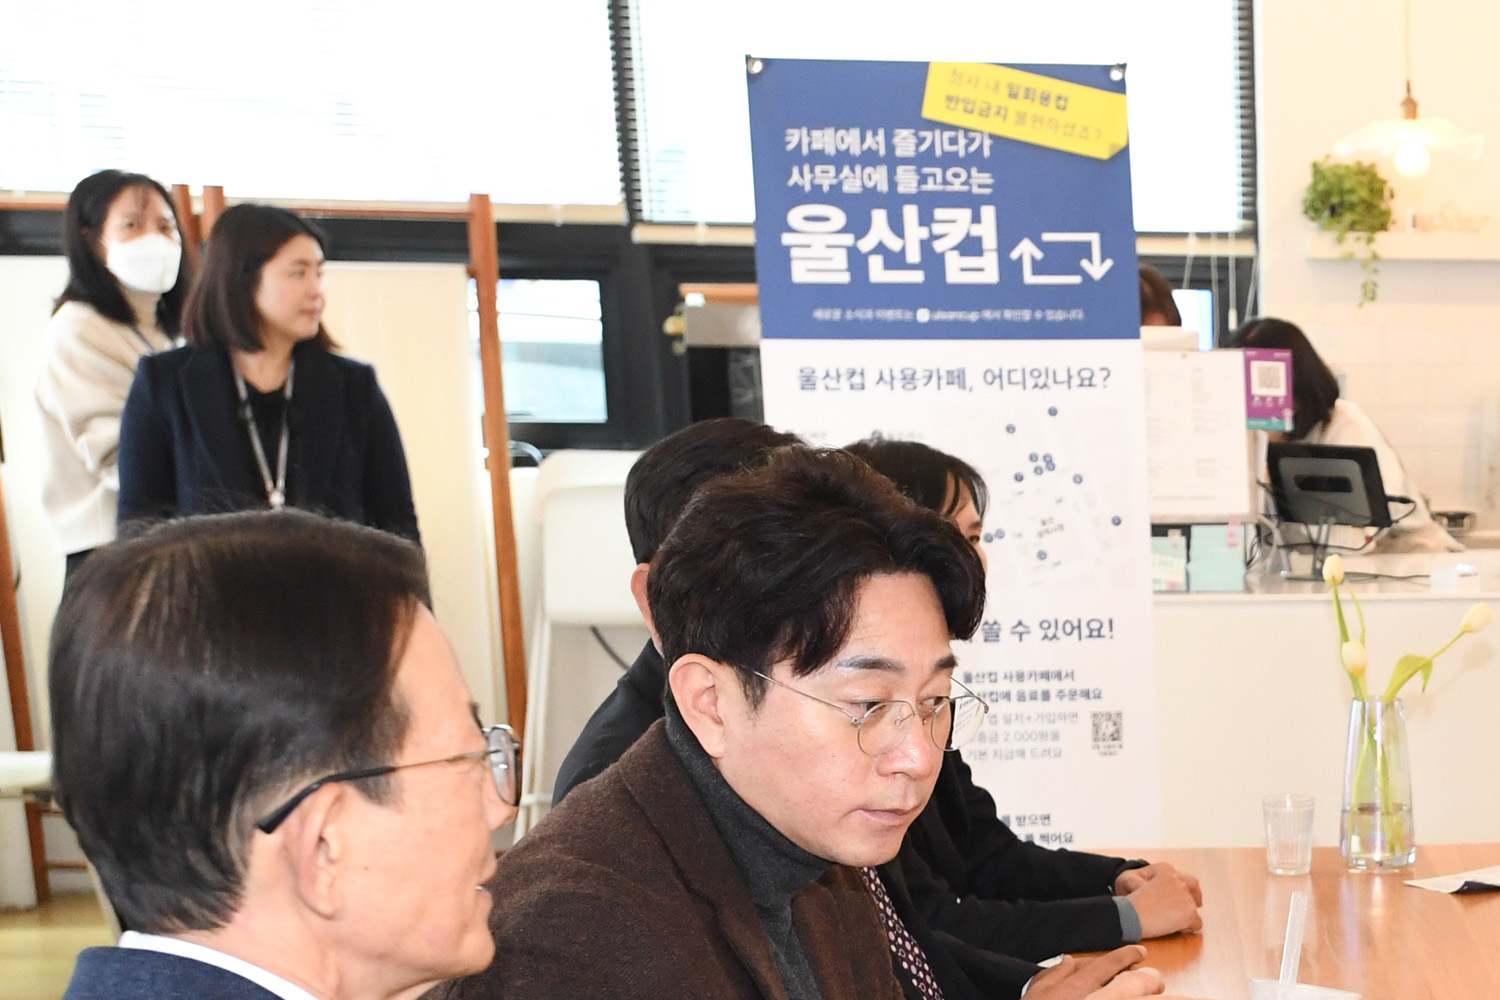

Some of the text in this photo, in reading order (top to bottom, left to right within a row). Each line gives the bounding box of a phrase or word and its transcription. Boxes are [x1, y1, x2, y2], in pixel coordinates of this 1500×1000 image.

[945, 94, 1009, 122] 반입금지
[1006, 82, 1069, 111] 일회용컵
[784, 126, 993, 158] 카페에서 즐기다가
[787, 164, 995, 194] 사무실에 들고오는
[780, 203, 1000, 284] 울산컵
[798, 366, 1113, 393] 울산컵 사용카페, 어디있나요?
[981, 617, 1115, 643] 쓸 수 있어요!
[1002, 668, 1076, 683] 사용카페에서
[1015, 688, 1051, 702] 음료를
[1015, 813, 1051, 828] 받으면
[1039, 831, 1074, 844] 찍어요
